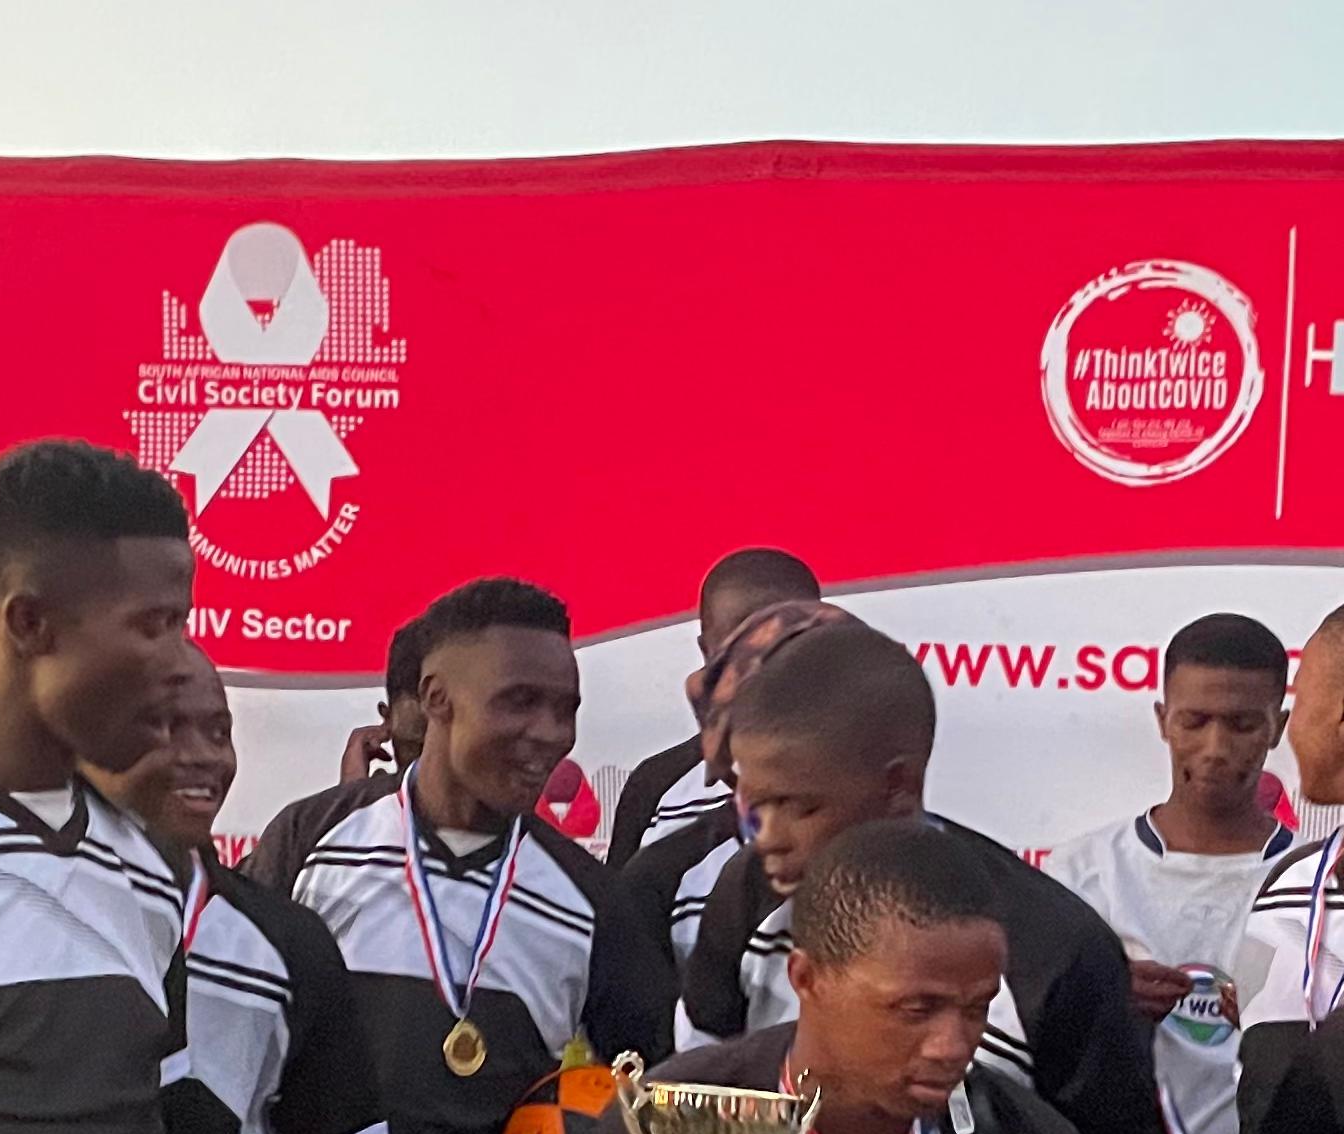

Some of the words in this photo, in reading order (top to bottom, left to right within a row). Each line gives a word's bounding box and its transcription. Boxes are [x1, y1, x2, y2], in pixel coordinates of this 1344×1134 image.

[139, 363, 182, 379] SOUTH
[185, 364, 241, 380] AFRICAN
[243, 366, 306, 381] NATIONAL
[308, 367, 339, 382] AIDS
[341, 367, 399, 382] COUNCIL
[1073, 345, 1226, 380] #ThinkTwice
[137, 379, 196, 405] Civil
[205, 380, 304, 411] Society
[312, 383, 399, 408] Forum
[1085, 377, 1229, 411] AboutCOVID
[188, 524, 292, 580] MMUNITIES
[292, 502, 360, 573] MATTER
[241, 608, 352, 642] Sector
